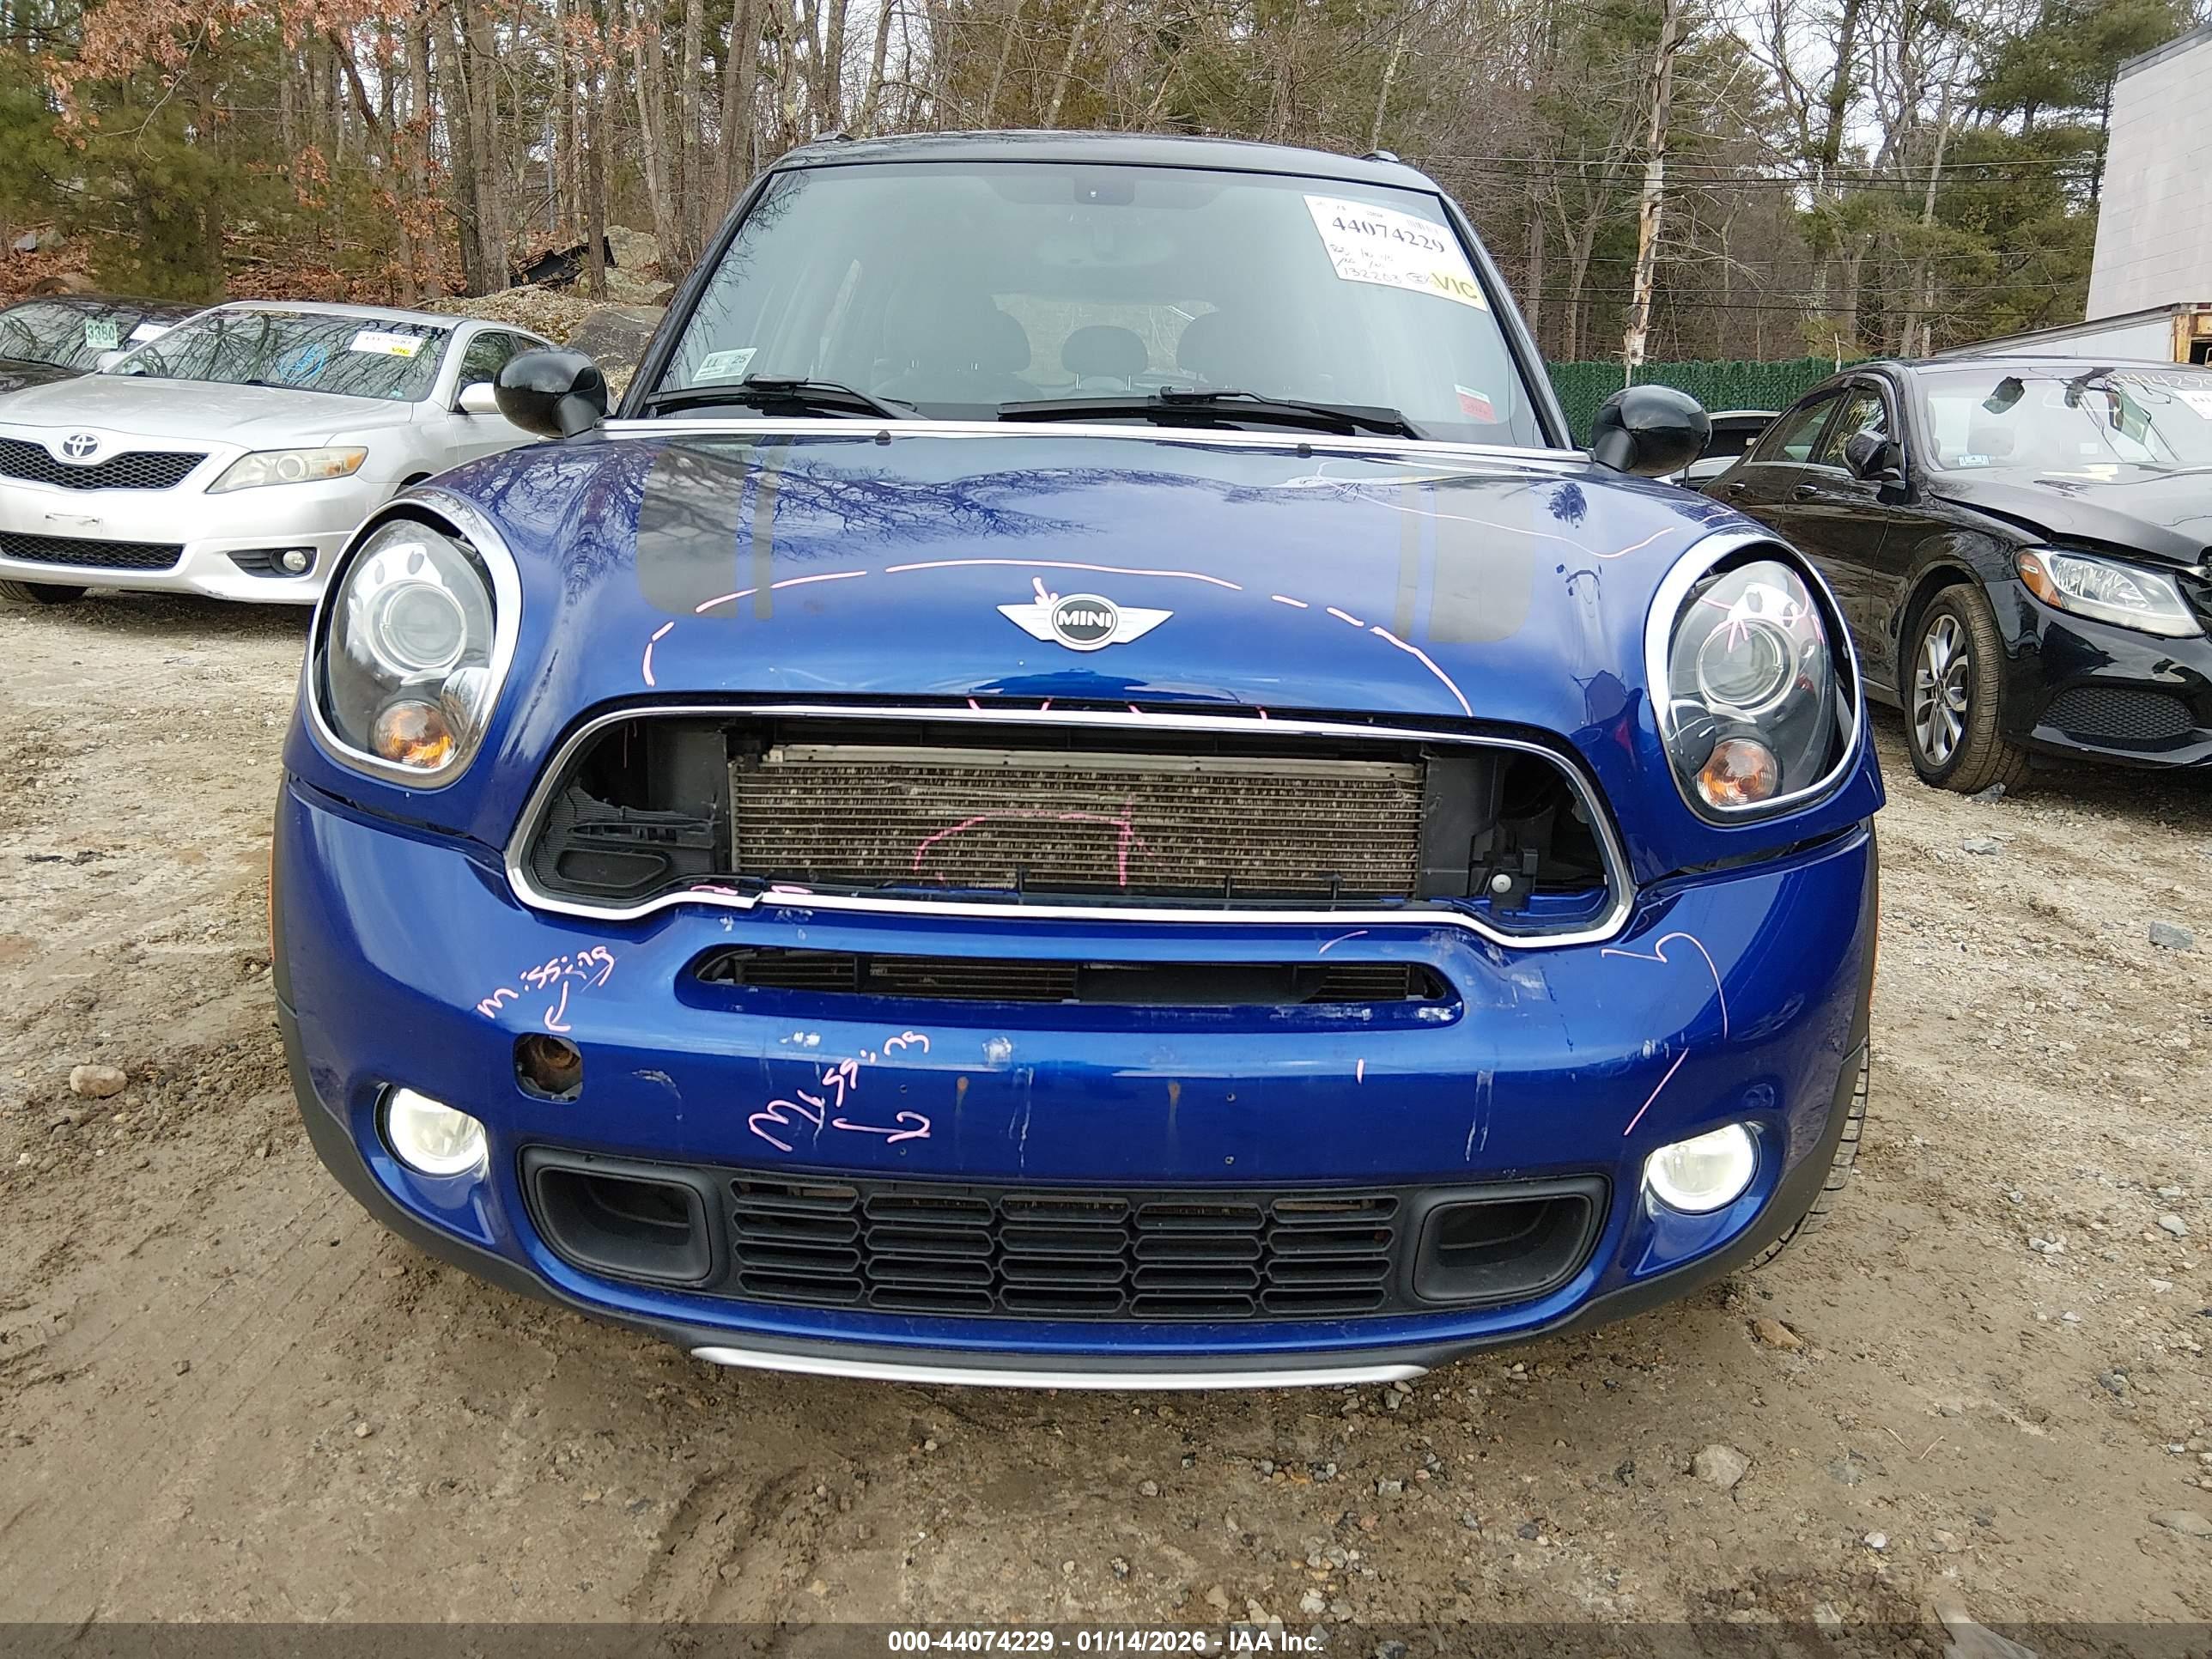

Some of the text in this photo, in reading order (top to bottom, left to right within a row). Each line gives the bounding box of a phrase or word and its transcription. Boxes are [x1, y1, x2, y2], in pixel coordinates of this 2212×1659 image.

[1332, 216, 1445, 253] 44074229
[1431, 272, 1478, 300] VIC
[87, 324, 116, 341] 3380
[732, 355, 747, 364] 25
[1058, 610, 1113, 628] MINI
